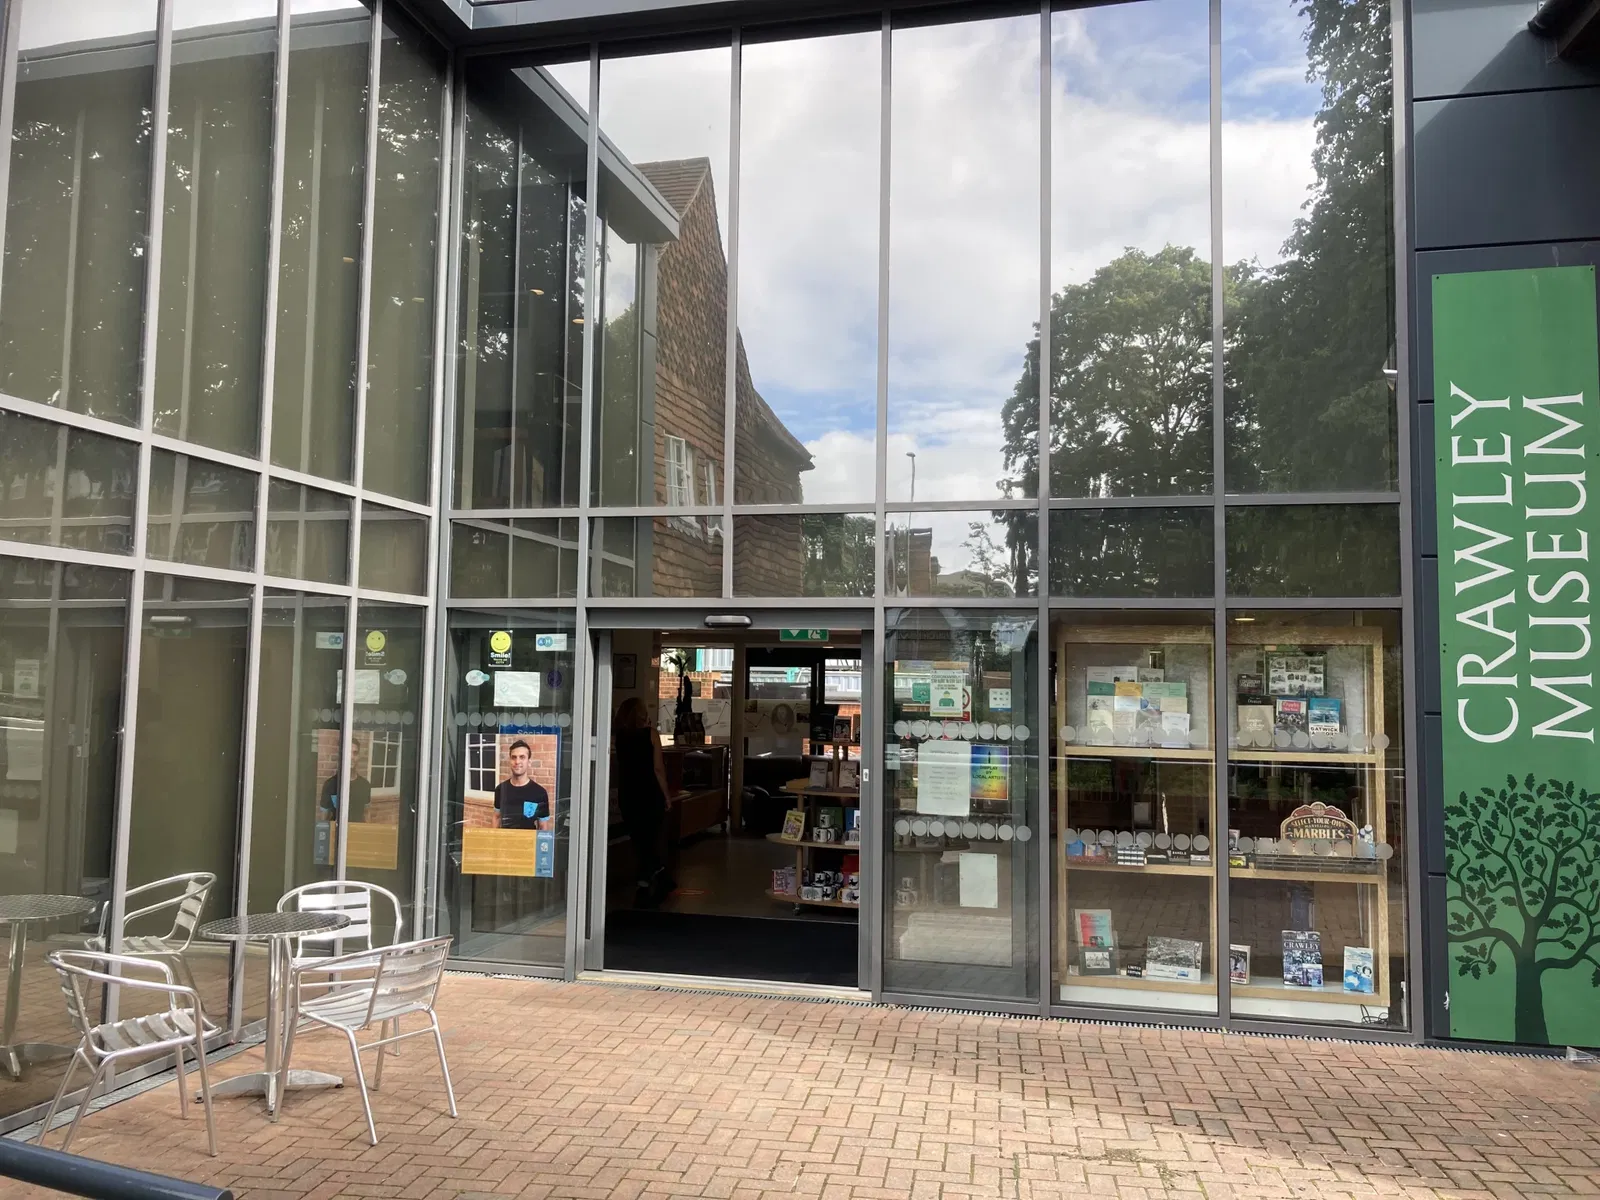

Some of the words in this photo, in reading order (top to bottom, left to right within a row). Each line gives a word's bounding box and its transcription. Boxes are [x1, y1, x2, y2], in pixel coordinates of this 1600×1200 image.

[1450, 380, 1519, 743] CRAWLEY
[1522, 391, 1594, 743] MUSEUM
[1293, 828, 1346, 840] MARBLES
[1283, 942, 1320, 950] CRAWLEY
